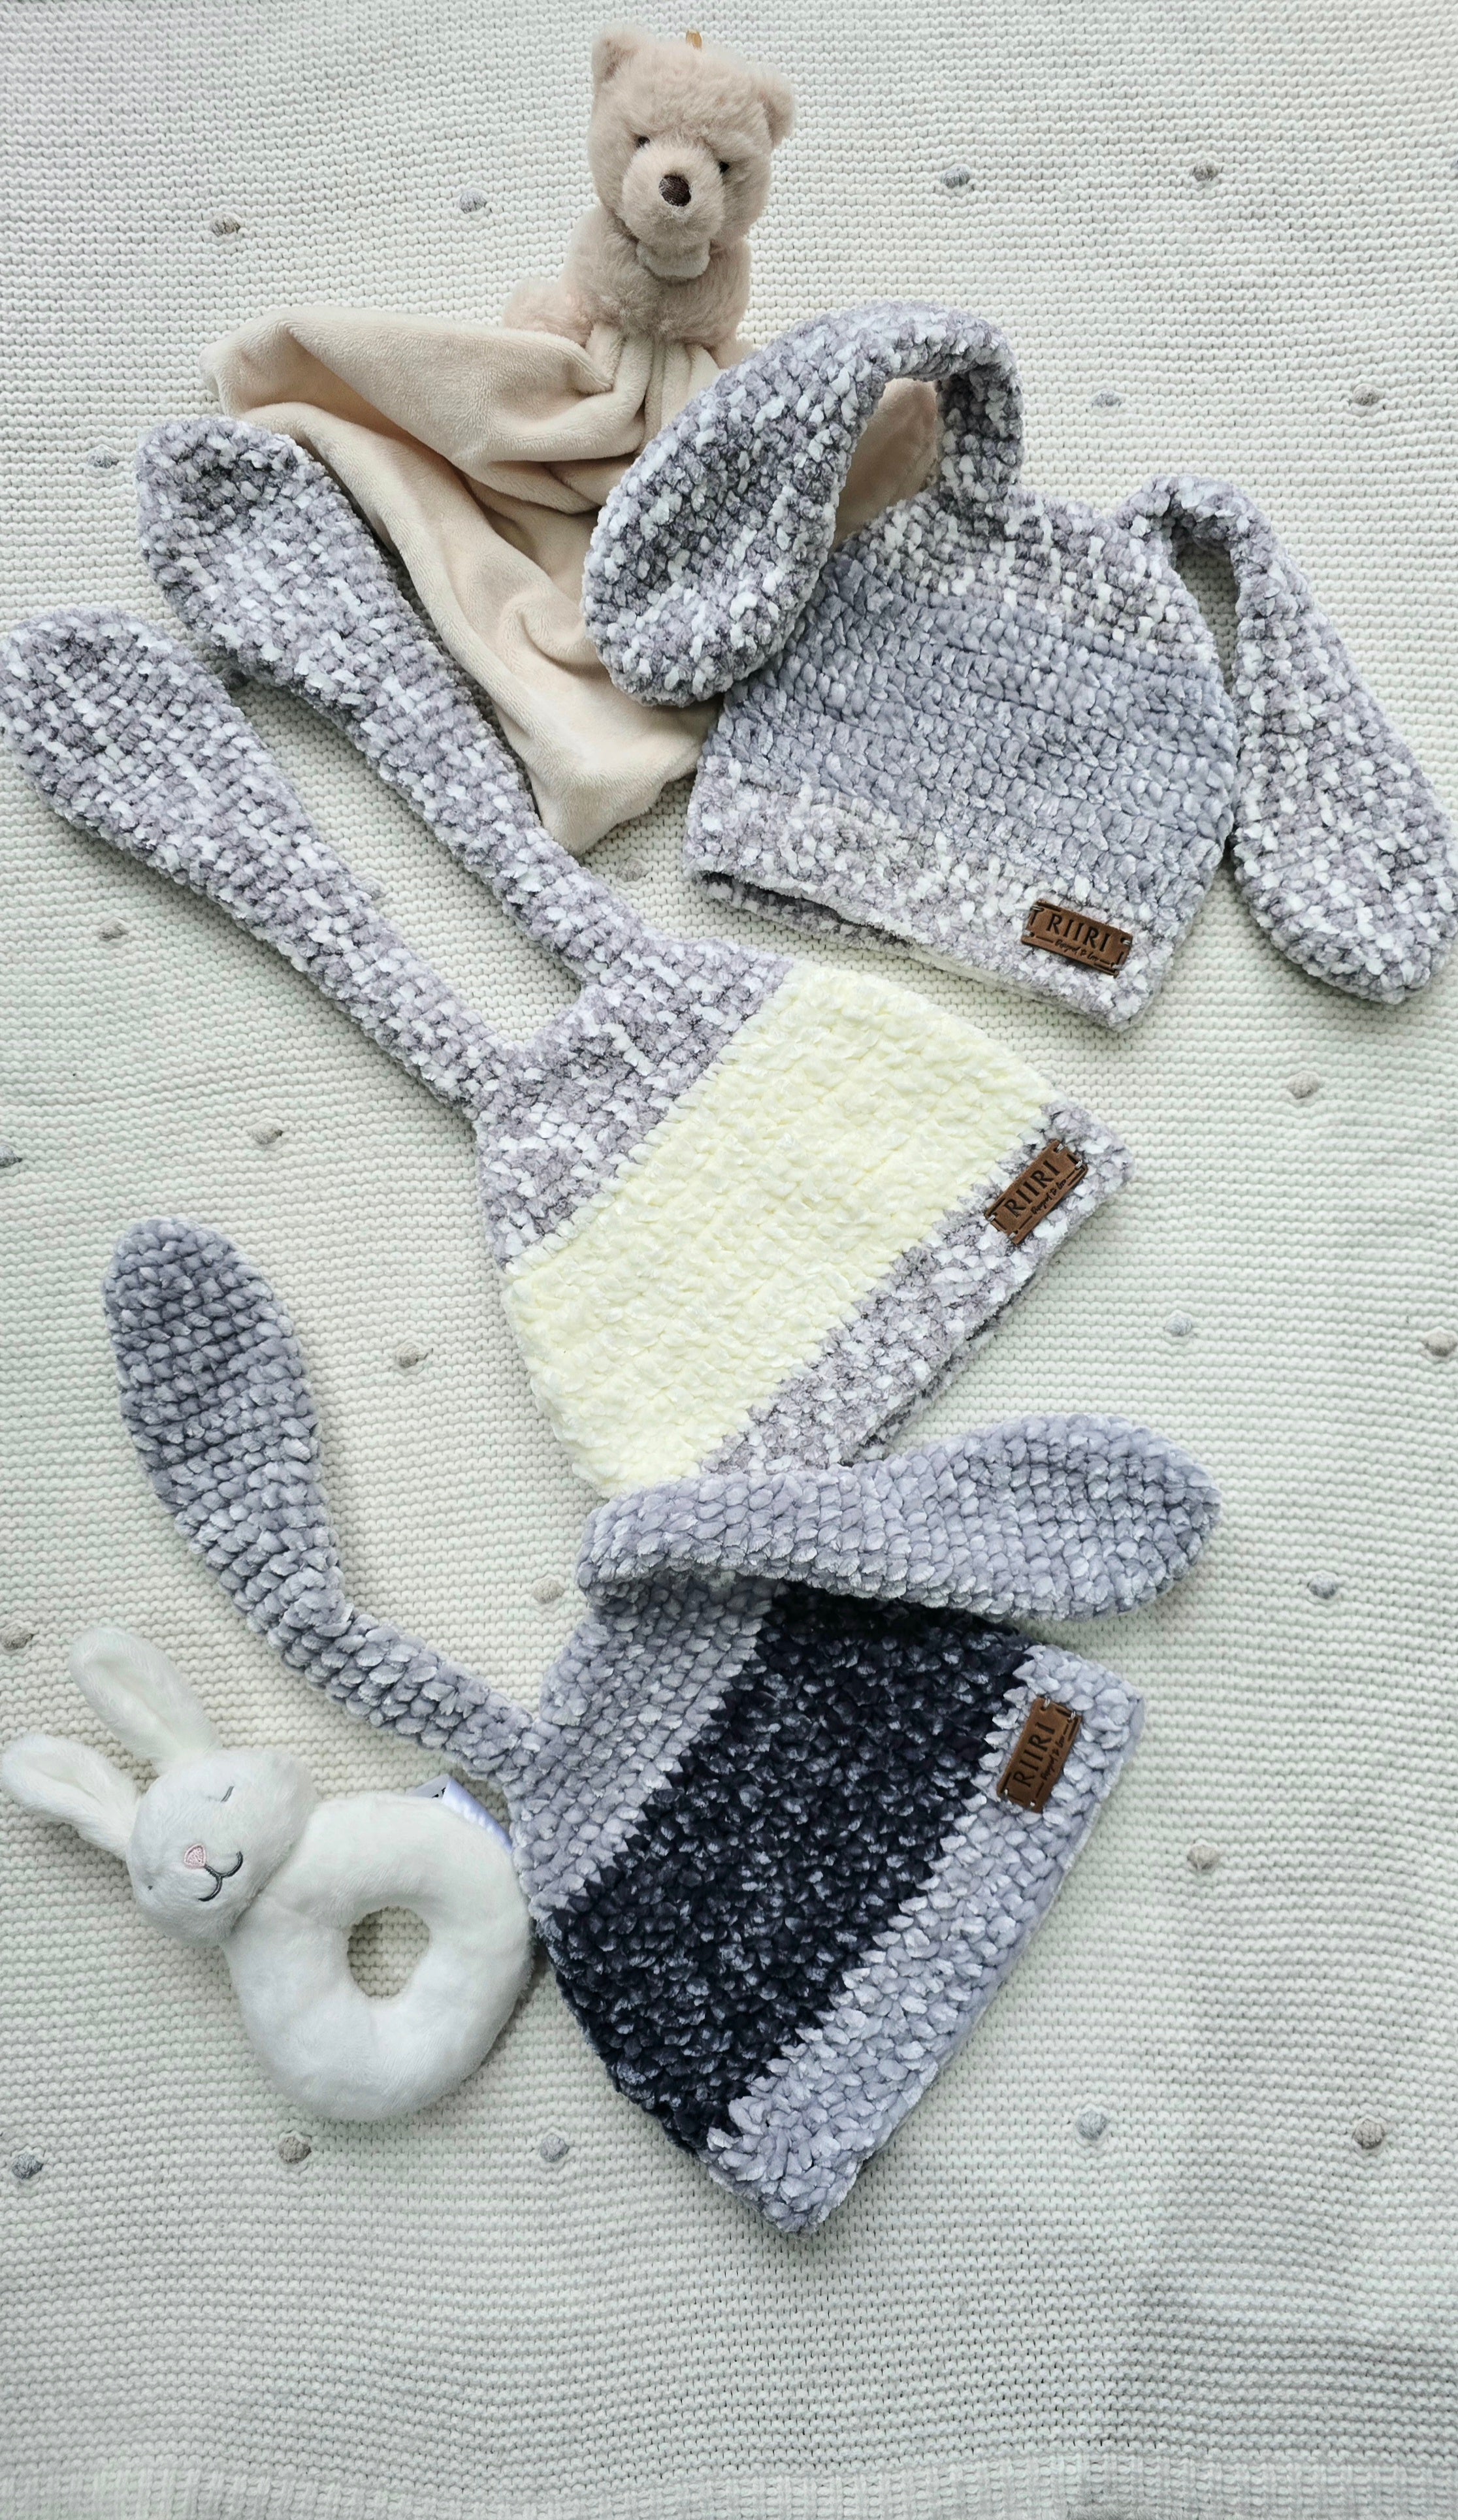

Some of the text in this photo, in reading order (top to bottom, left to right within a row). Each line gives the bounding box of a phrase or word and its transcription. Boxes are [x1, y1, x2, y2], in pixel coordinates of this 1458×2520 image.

[1046, 913, 1110, 952] RIIRI
[1004, 1160, 1060, 1218] RIIRI
[1013, 1722, 1056, 1788] RIIRI
